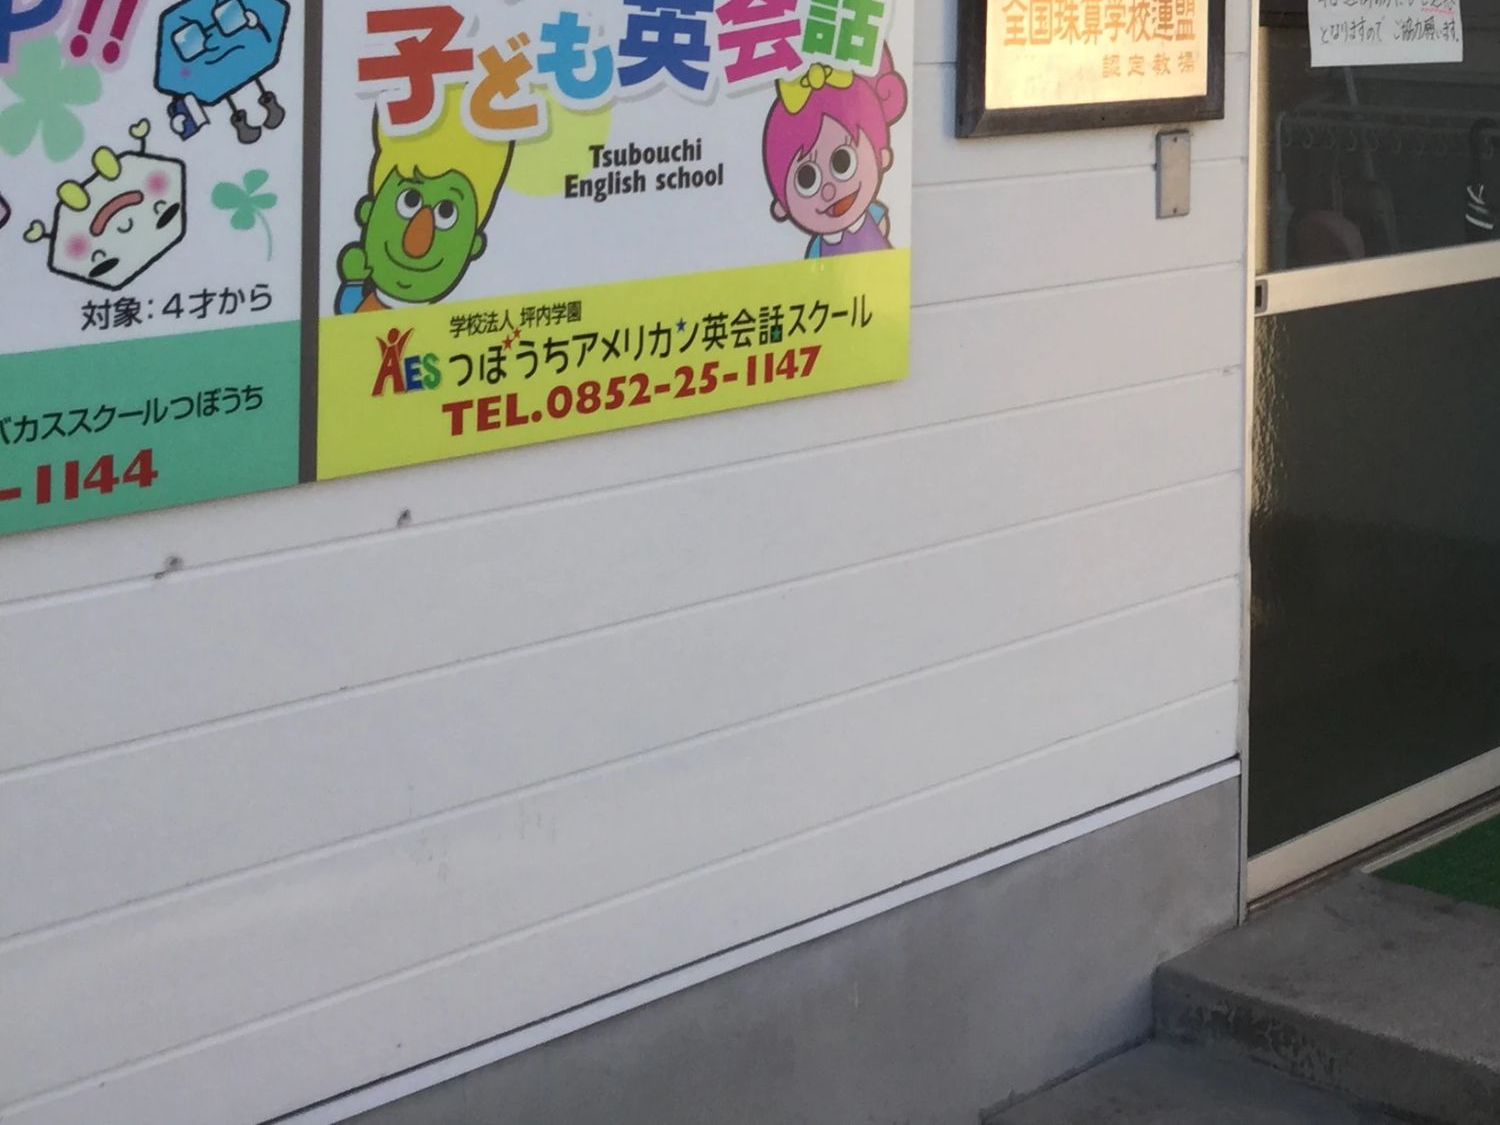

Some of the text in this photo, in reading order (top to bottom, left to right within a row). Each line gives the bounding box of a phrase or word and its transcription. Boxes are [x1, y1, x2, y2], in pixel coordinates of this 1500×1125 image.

[564, 163, 724, 203] English school
[588, 138, 702, 169] Tsubouchi
[371, 327, 443, 397] AES
[448, 293, 873, 388] つぼうちアメリカン英会話スクール
[441, 344, 823, 437] TEL.0852-25-1147
